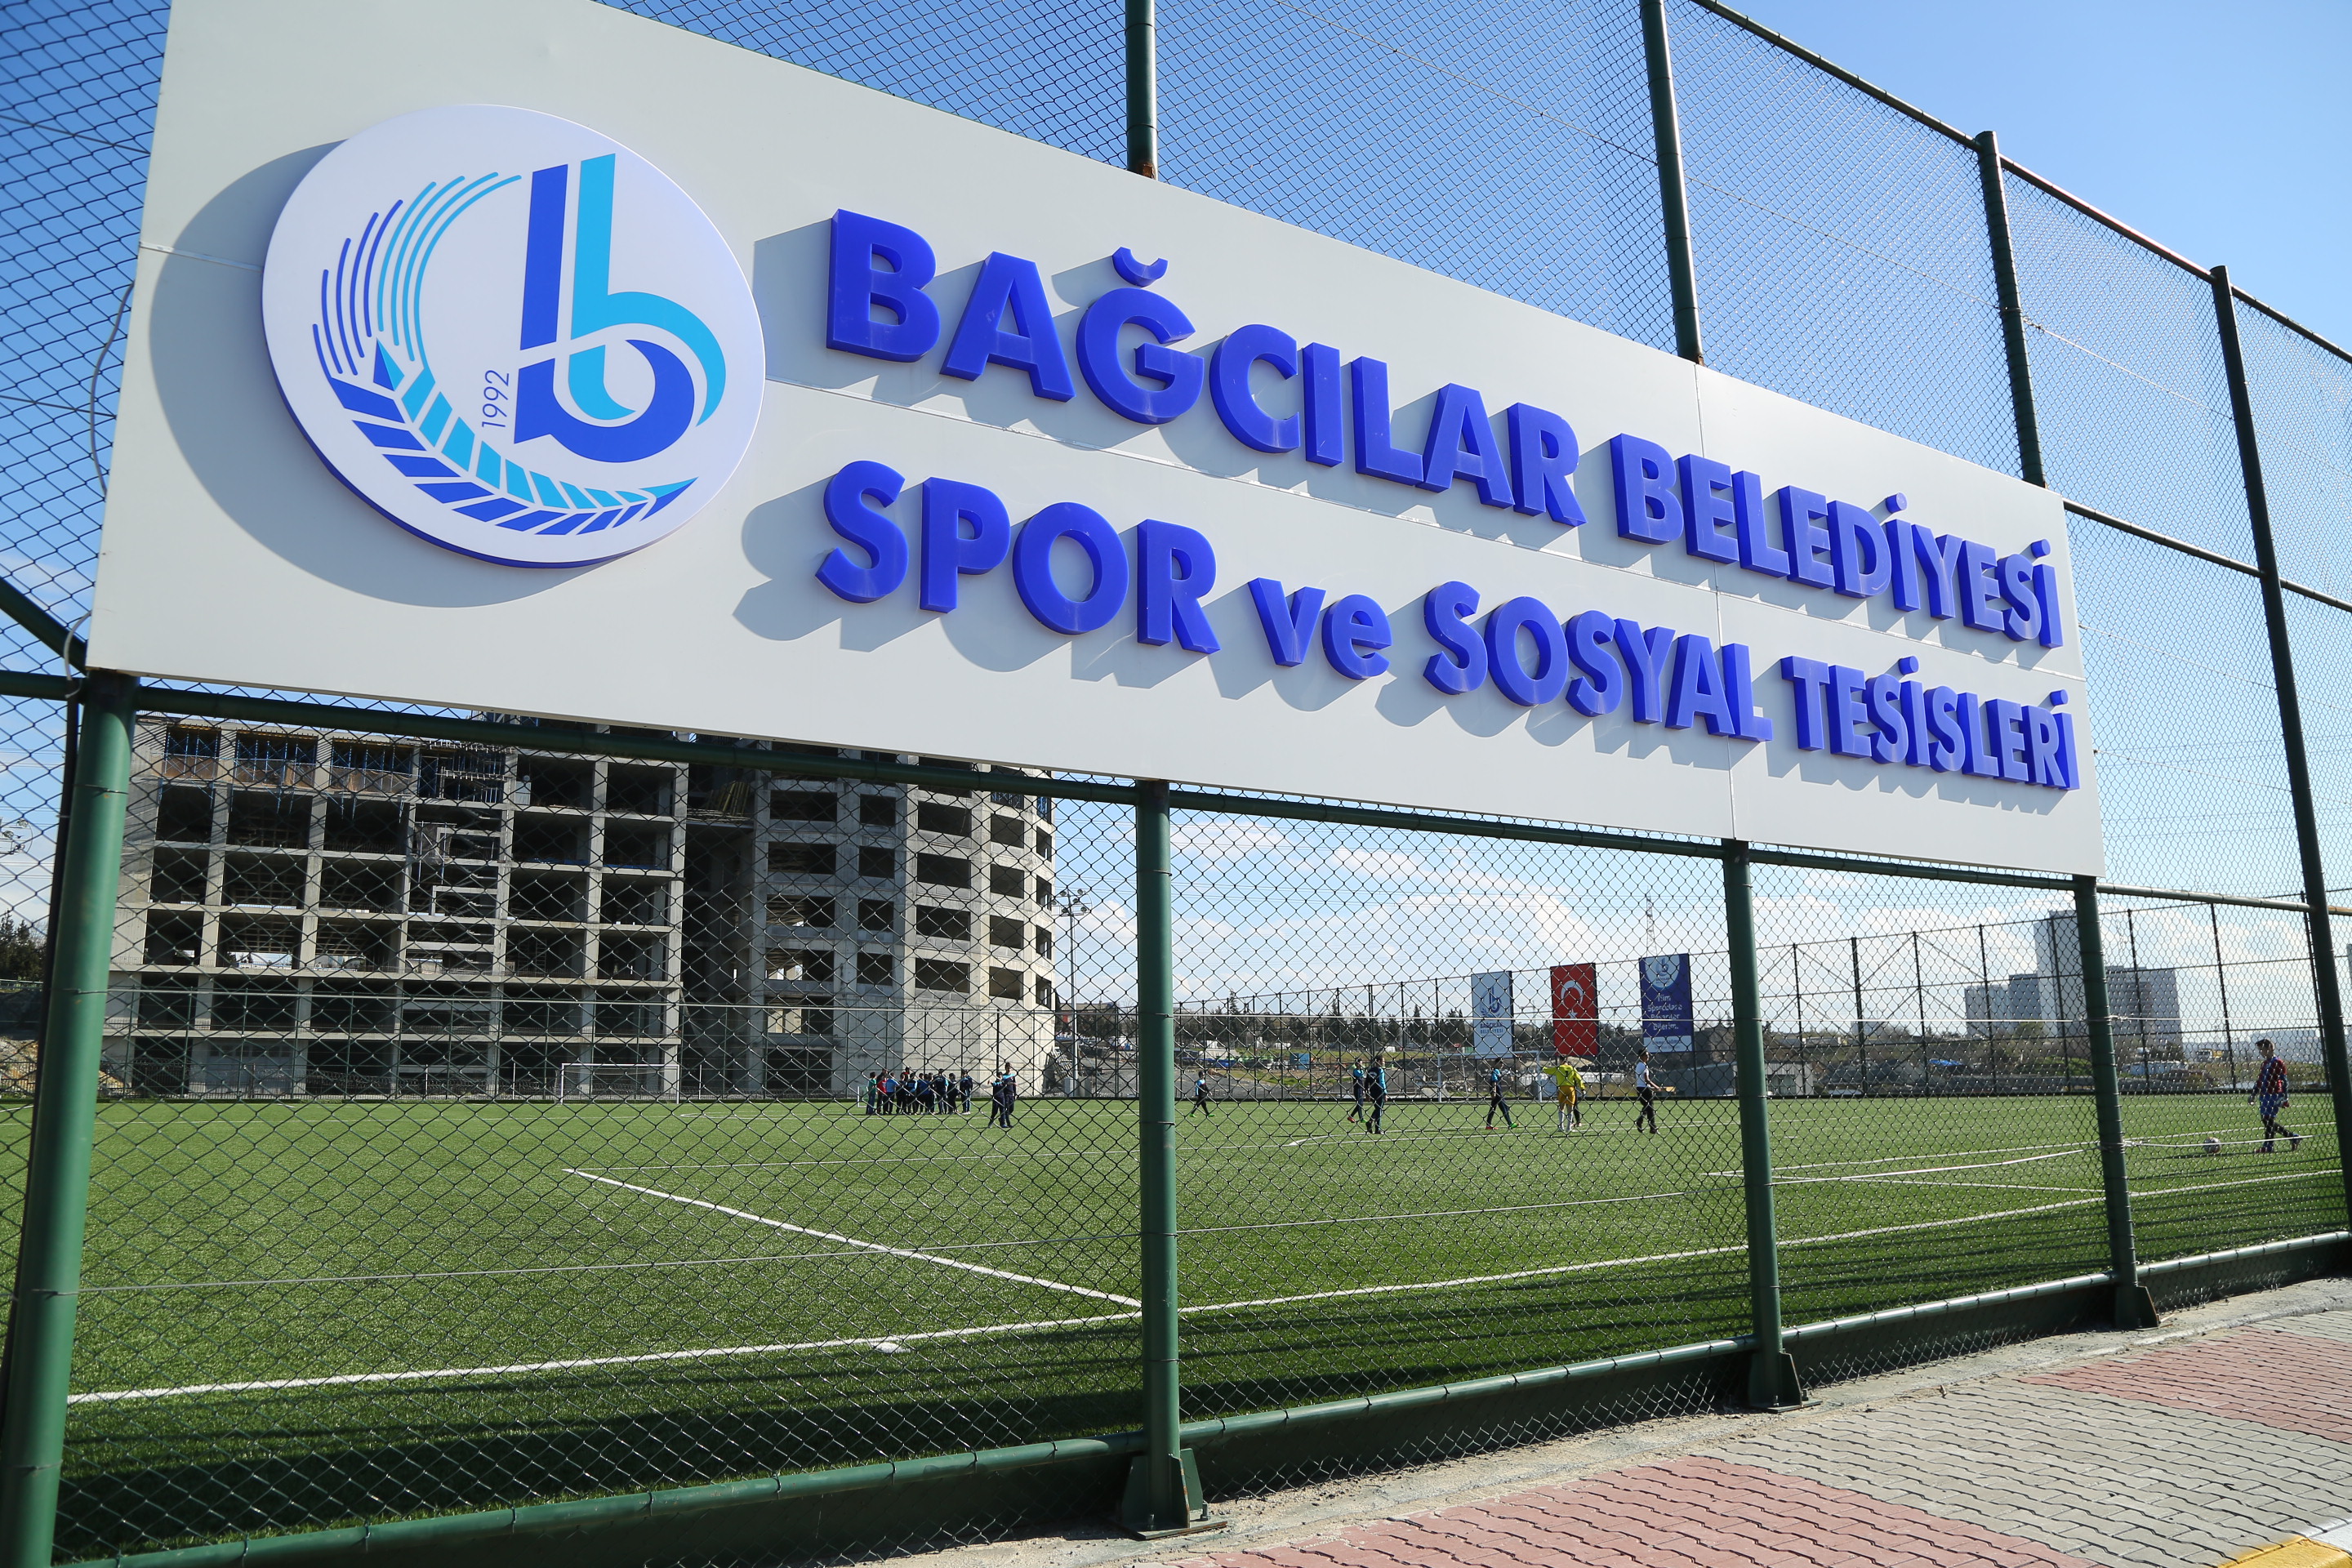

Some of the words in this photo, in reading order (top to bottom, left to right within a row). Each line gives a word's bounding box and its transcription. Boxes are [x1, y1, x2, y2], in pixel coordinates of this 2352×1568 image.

[481, 369, 510, 428] 1992
[826, 208, 1588, 528] BAĞCILAR
[1609, 433, 2064, 649] BELEDİYESİ
[814, 460, 1222, 656] SPOR
[1247, 577, 1393, 681] ve
[1423, 581, 1773, 742] SOSYAL
[1780, 655, 2081, 791] TESİSLERİ
